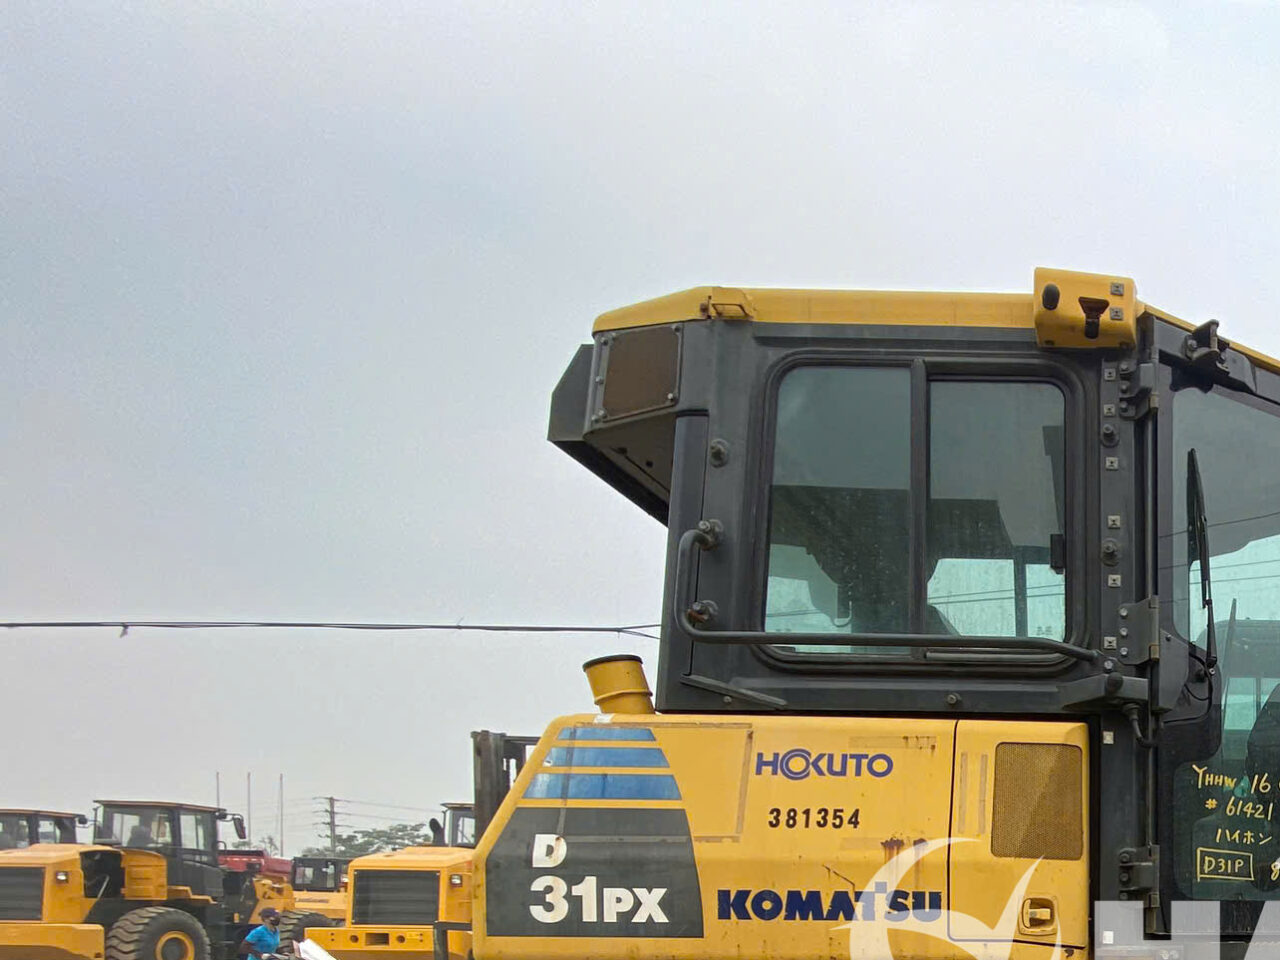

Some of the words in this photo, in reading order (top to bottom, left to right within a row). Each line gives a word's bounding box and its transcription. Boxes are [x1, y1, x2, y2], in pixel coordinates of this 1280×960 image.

[755, 748, 894, 781] HOKUTO
[1250, 773, 1271, 794] 16
[768, 807, 860, 829] 381354
[1226, 796, 1274, 821] 61421
[532, 833, 568, 868] D
[1203, 856, 1244, 874] D31P
[529, 875, 669, 924] 31PX
[717, 881, 942, 922] KOMATSU
